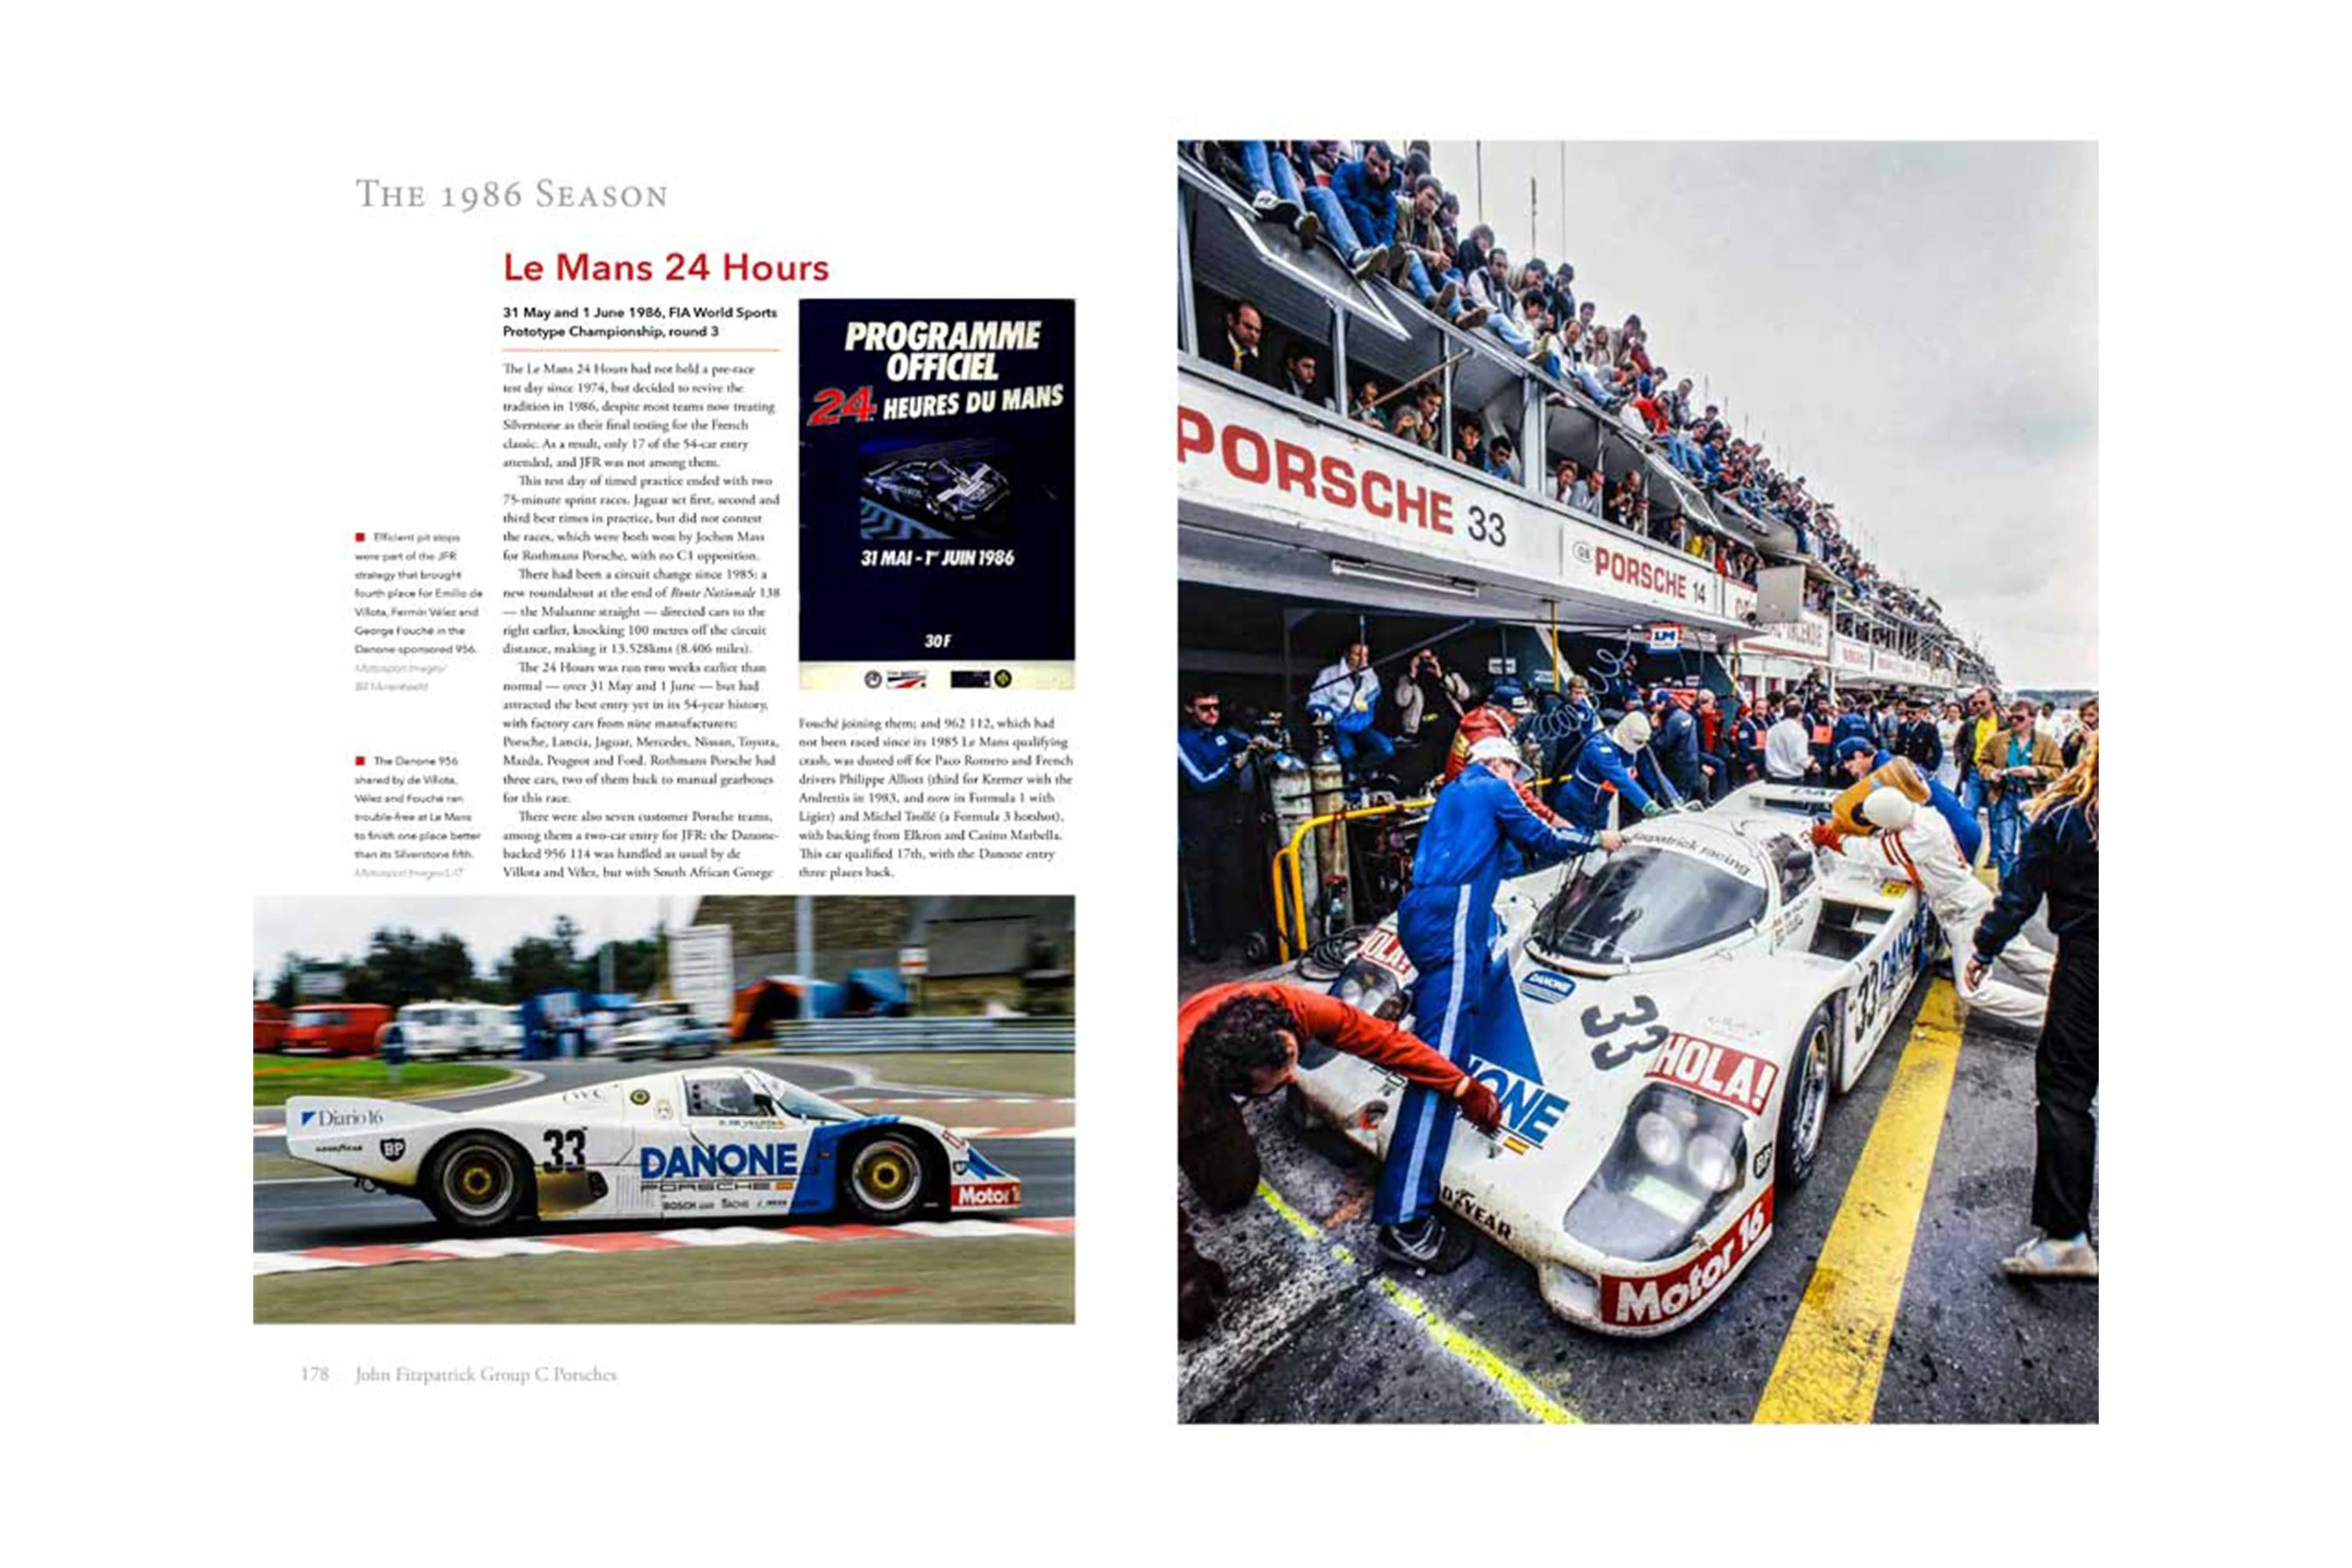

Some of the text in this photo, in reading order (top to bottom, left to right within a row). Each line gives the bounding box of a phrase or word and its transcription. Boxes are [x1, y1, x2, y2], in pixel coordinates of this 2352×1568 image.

[443, 181, 522, 213] 1986
[505, 252, 829, 282] Le Mans 24 Hours
[503, 307, 779, 321] 31 May and 1 June 1986, FIA World Sports
[503, 325, 720, 340] Prototype Championship, round 3
[844, 320, 1043, 352] PROGRAMME
[886, 352, 1000, 382] OFFICIEL
[806, 383, 1065, 427] 24 HEURES DU MANS
[1178, 405, 1507, 548] PORSCHE 33
[503, 494, 562, 505] 75-minute
[564, 497, 597, 507] sprint
[633, 494, 669, 507] Jaguar
[717, 494, 757, 505] second
[758, 494, 781, 505] and
[503, 550, 519, 561] for
[521, 550, 579, 561] Rothmans
[630, 550, 657, 561] with
[676, 550, 694, 560] C1
[861, 549, 879, 567] 31
[880, 549, 913, 567] MAI
[941, 549, 978, 567] JUIN
[978, 549, 1016, 567] 1986
[1595, 546, 1686, 600] PORSCHE
[1693, 581, 1707, 604] 14
[528, 587, 594, 598] roundabout
[610, 587, 629, 598] the
[630, 587, 653, 598] end
[654, 586, 669, 597] of
[670, 587, 702, 597] Route
[702, 586, 757, 597] Nationale
[760, 588, 782, 597] 138
[554, 643, 597, 656] making
[546, 754, 590, 768] Peugeot
[592, 755, 615, 766] and
[650, 754, 708, 765] Rothmans
[710, 754, 753, 765] Porsche
[754, 754, 777, 766] had
[798, 774, 837, 785] drivers
[839, 773, 886, 787] Philippe
[887, 774, 924, 784] Alliott
[962, 773, 979, 784] for
[982, 774, 1024, 784] Kremer
[1025, 773, 1052, 784] with
[1054, 774, 1073, 784] the
[838, 811, 860, 822] and
[862, 811, 902, 822] Michel
[904, 811, 937, 822] Trollé
[953, 811, 1000, 822] Formula
[1003, 811, 1011, 822] 3
[798, 829, 825, 840] with
[826, 829, 871, 844] backing
[872, 829, 901, 840] from
[903, 829, 942, 840] Elkron
[944, 829, 966, 840] and
[967, 829, 1008, 840] Casino
[1698, 845, 1751, 877] racing
[1855, 960, 1880, 1044] 33
[1580, 994, 1670, 1072] 33
[1653, 1036, 1777, 1110] HOLA!
[542, 1127, 587, 1174] 33
[640, 1142, 798, 1180] DANONE
[959, 1185, 1010, 1206] Motor
[1615, 1200, 1765, 1323] Motor 16
[301, 1366, 330, 1382] 178
[355, 1365, 619, 1387] John Fitzpatrick Group C Porsches
